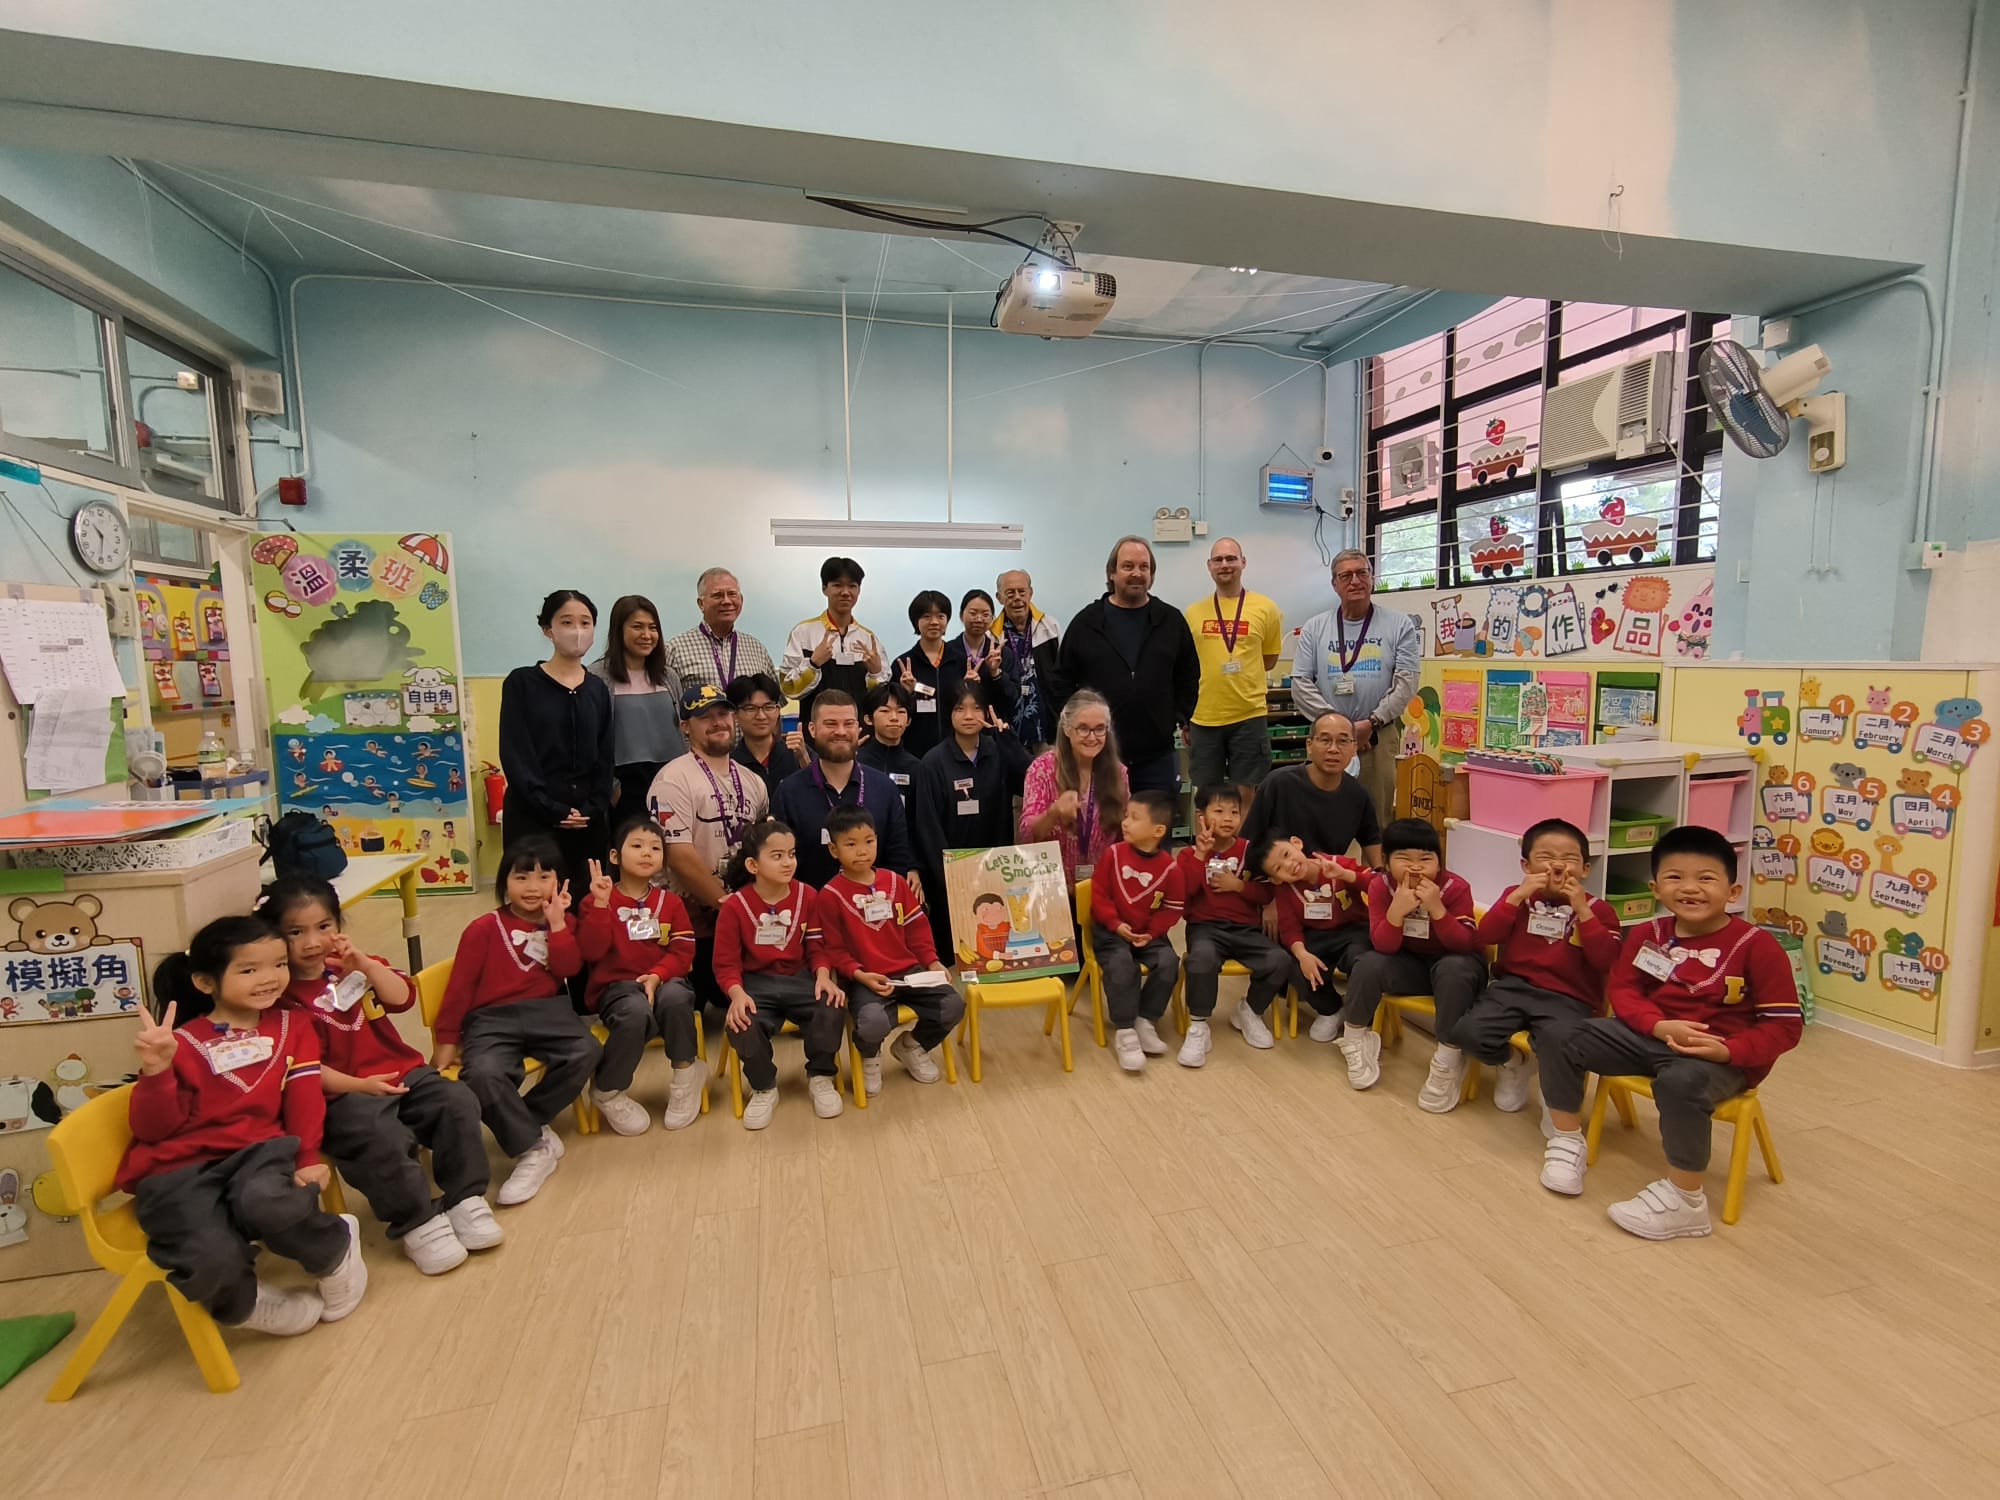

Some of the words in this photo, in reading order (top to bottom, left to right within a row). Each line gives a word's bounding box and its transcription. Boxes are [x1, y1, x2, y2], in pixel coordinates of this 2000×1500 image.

[408, 690, 452, 704] 自由角
[1837, 699, 1846, 714] 1
[1899, 706, 1912, 721] 2
[1808, 713, 1831, 724] 一月
[1865, 717, 1889, 729] 二月
[1803, 726, 1837, 736] January
[1858, 730, 1899, 743] February
[1966, 724, 1981, 742] 3
[1930, 731, 1957, 747] 三月
[1926, 746, 1954, 761] March
[1797, 777, 1810, 791] 6
[1865, 782, 1879, 798] 5
[1773, 792, 1793, 802] 六月
[1834, 794, 1857, 806] 五月
[1937, 789, 1952, 805] 4
[1778, 806, 1796, 814] June
[1838, 808, 1854, 817] May
[1904, 801, 1930, 812] 四月
[1907, 817, 1935, 827] April
[1783, 838, 1794, 853] 7
[985, 855, 1010, 871] Let's
[1761, 853, 1781, 863] 七月
[1849, 853, 1863, 869] 8
[1001, 862, 1058, 883] Smoie
[1766, 868, 1784, 876] July
[1822, 864, 1845, 878] 八月
[1885, 879, 1911, 895] 九月
[1915, 873, 1930, 888] 9
[1874, 890, 1922, 910] September
[1786, 921, 1804, 936] 12
[1852, 933, 1872, 950] 11
[1823, 941, 1855, 959] 十一月
[1823, 955, 1861, 972] November
[1896, 960, 1921, 974] 十月
[1922, 951, 1945, 969] 10
[5, 954, 128, 992] 模擬角
[1892, 975, 1931, 987] October
